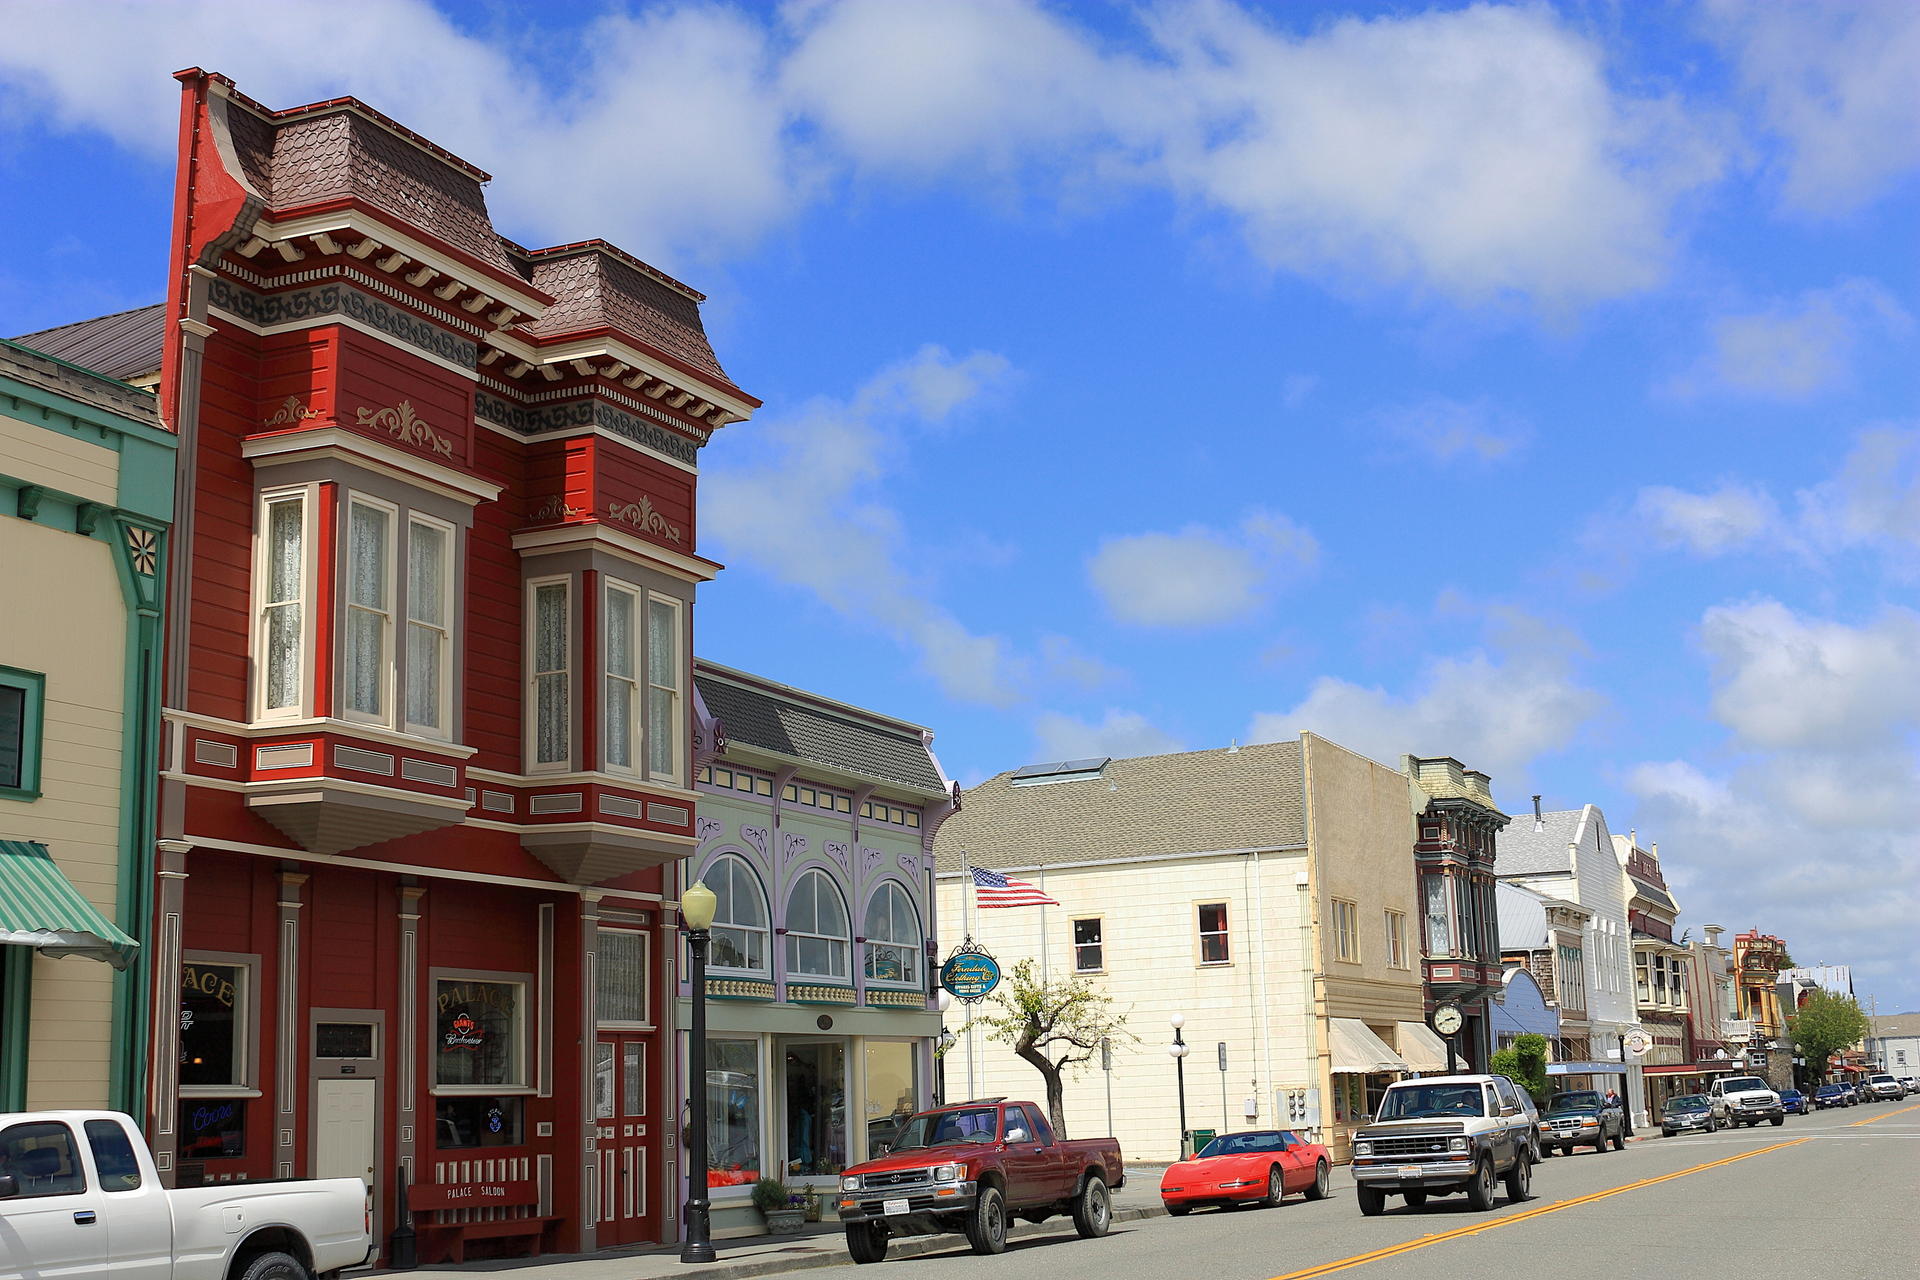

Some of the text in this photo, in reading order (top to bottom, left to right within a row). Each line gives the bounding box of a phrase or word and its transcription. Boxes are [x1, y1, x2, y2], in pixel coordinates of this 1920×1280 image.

[951, 962, 988, 973] Ferndale
[945, 972, 981, 984] Clothing
[437, 984, 516, 1019] PALACE
[453, 1019, 475, 1030] GIANTS
[193, 1104, 233, 1131] Coors
[447, 1185, 506, 1199] PALACE SALOON
